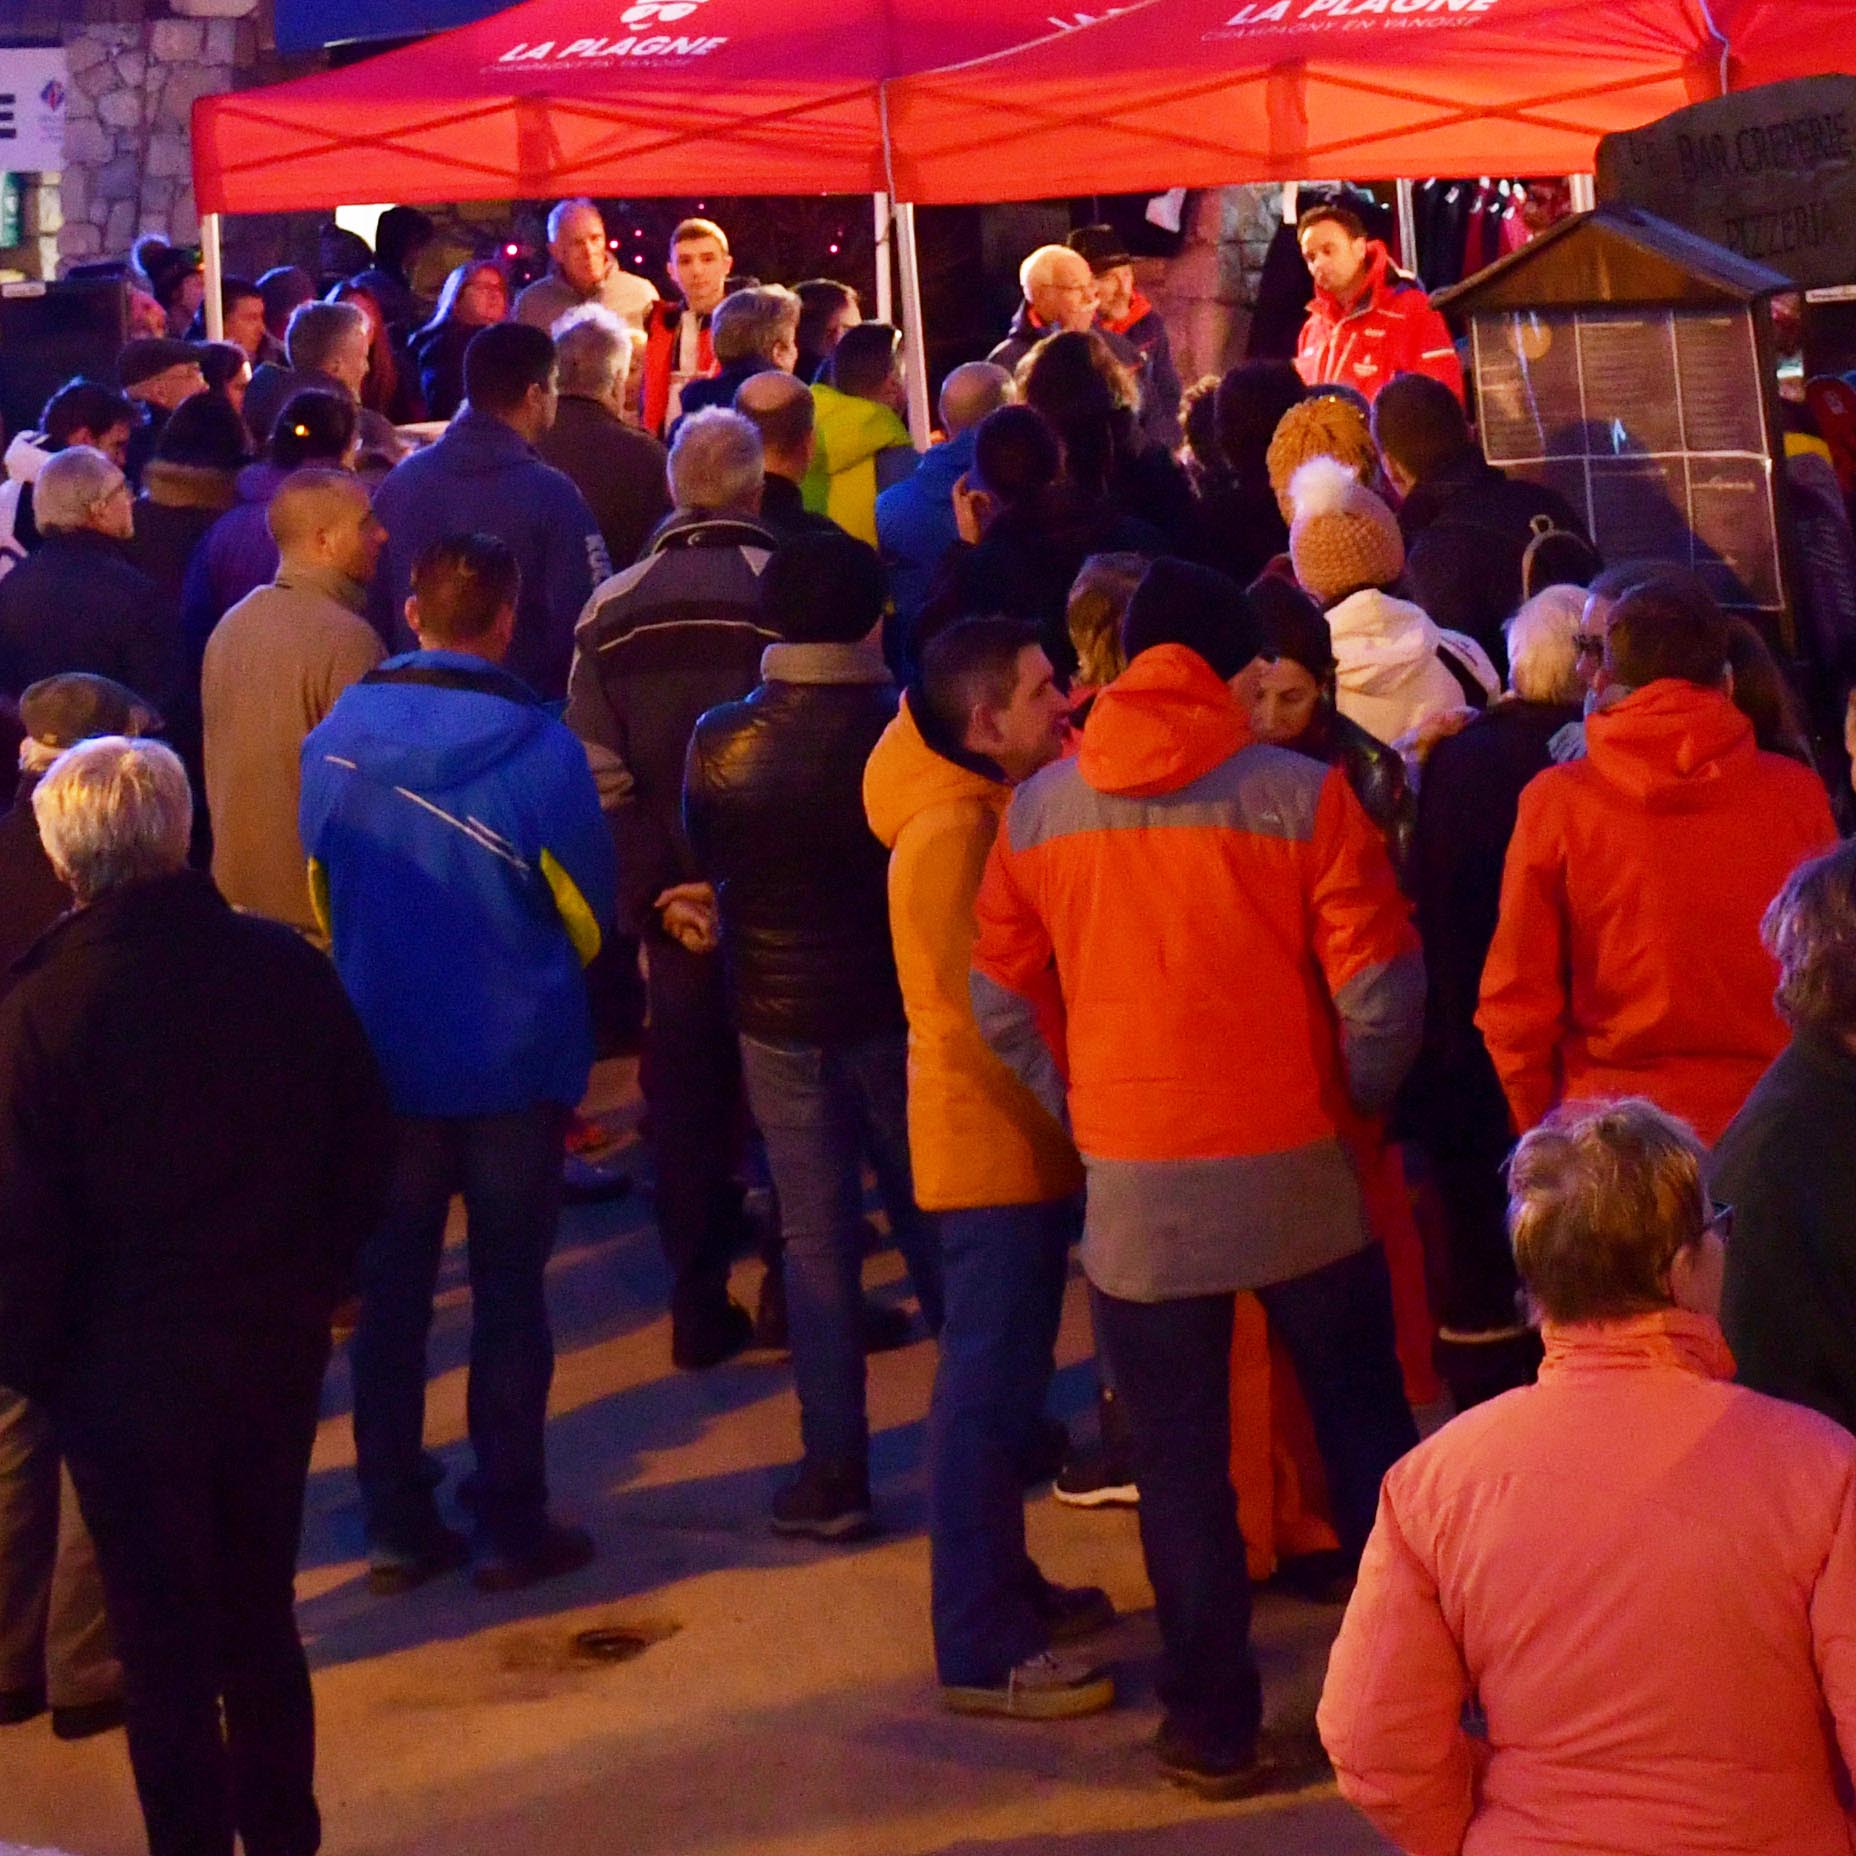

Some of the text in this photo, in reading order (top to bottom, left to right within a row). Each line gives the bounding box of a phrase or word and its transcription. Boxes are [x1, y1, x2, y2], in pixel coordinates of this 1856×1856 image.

[1226, 0, 1292, 26] LA
[499, 36, 728, 62] LA PLAGNE
